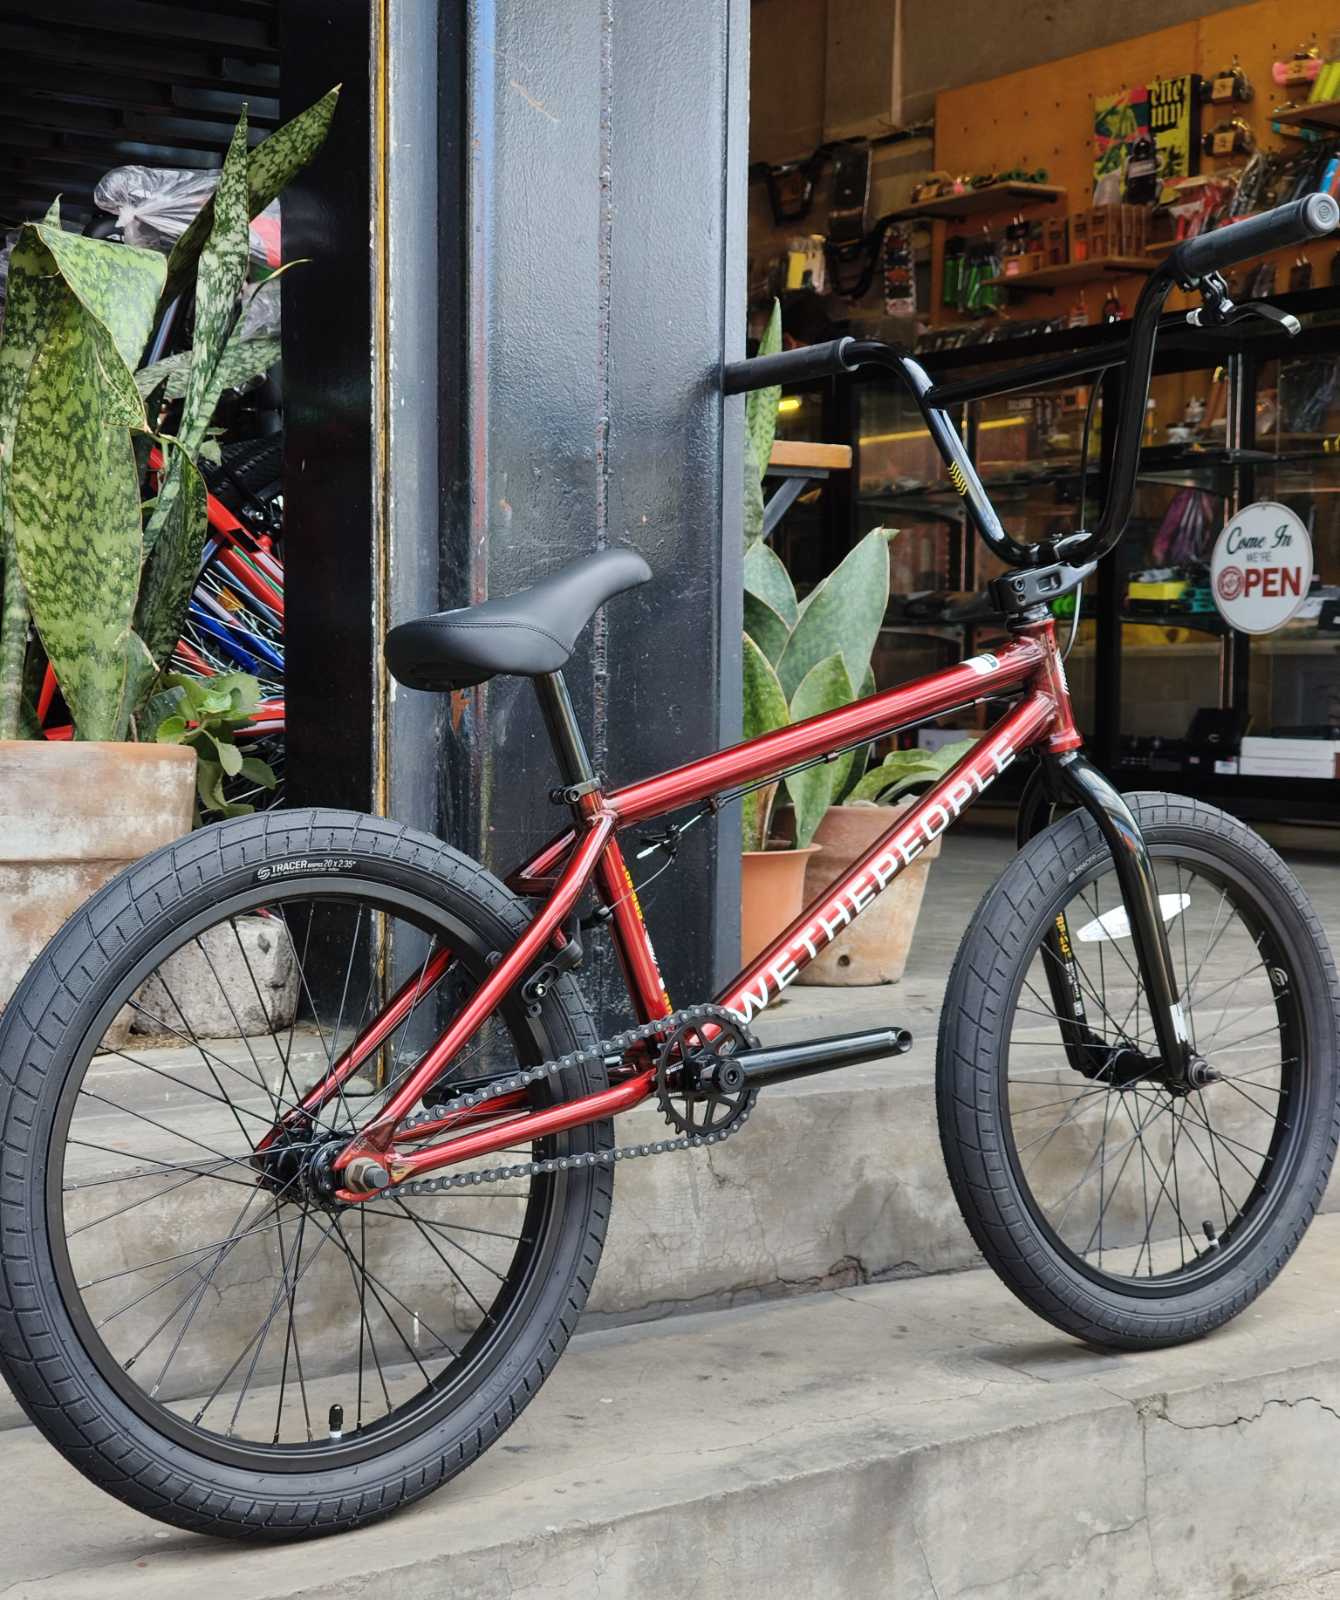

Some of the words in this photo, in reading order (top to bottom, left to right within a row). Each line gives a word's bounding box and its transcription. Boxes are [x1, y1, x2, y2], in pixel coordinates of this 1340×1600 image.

[1226, 526, 1266, 555] Come
[1271, 524, 1292, 549] In
[1217, 566, 1302, 601] OPEN
[271, 860, 308, 873] TRACER
[732, 733, 1016, 1024] WETHEPEOPLE
